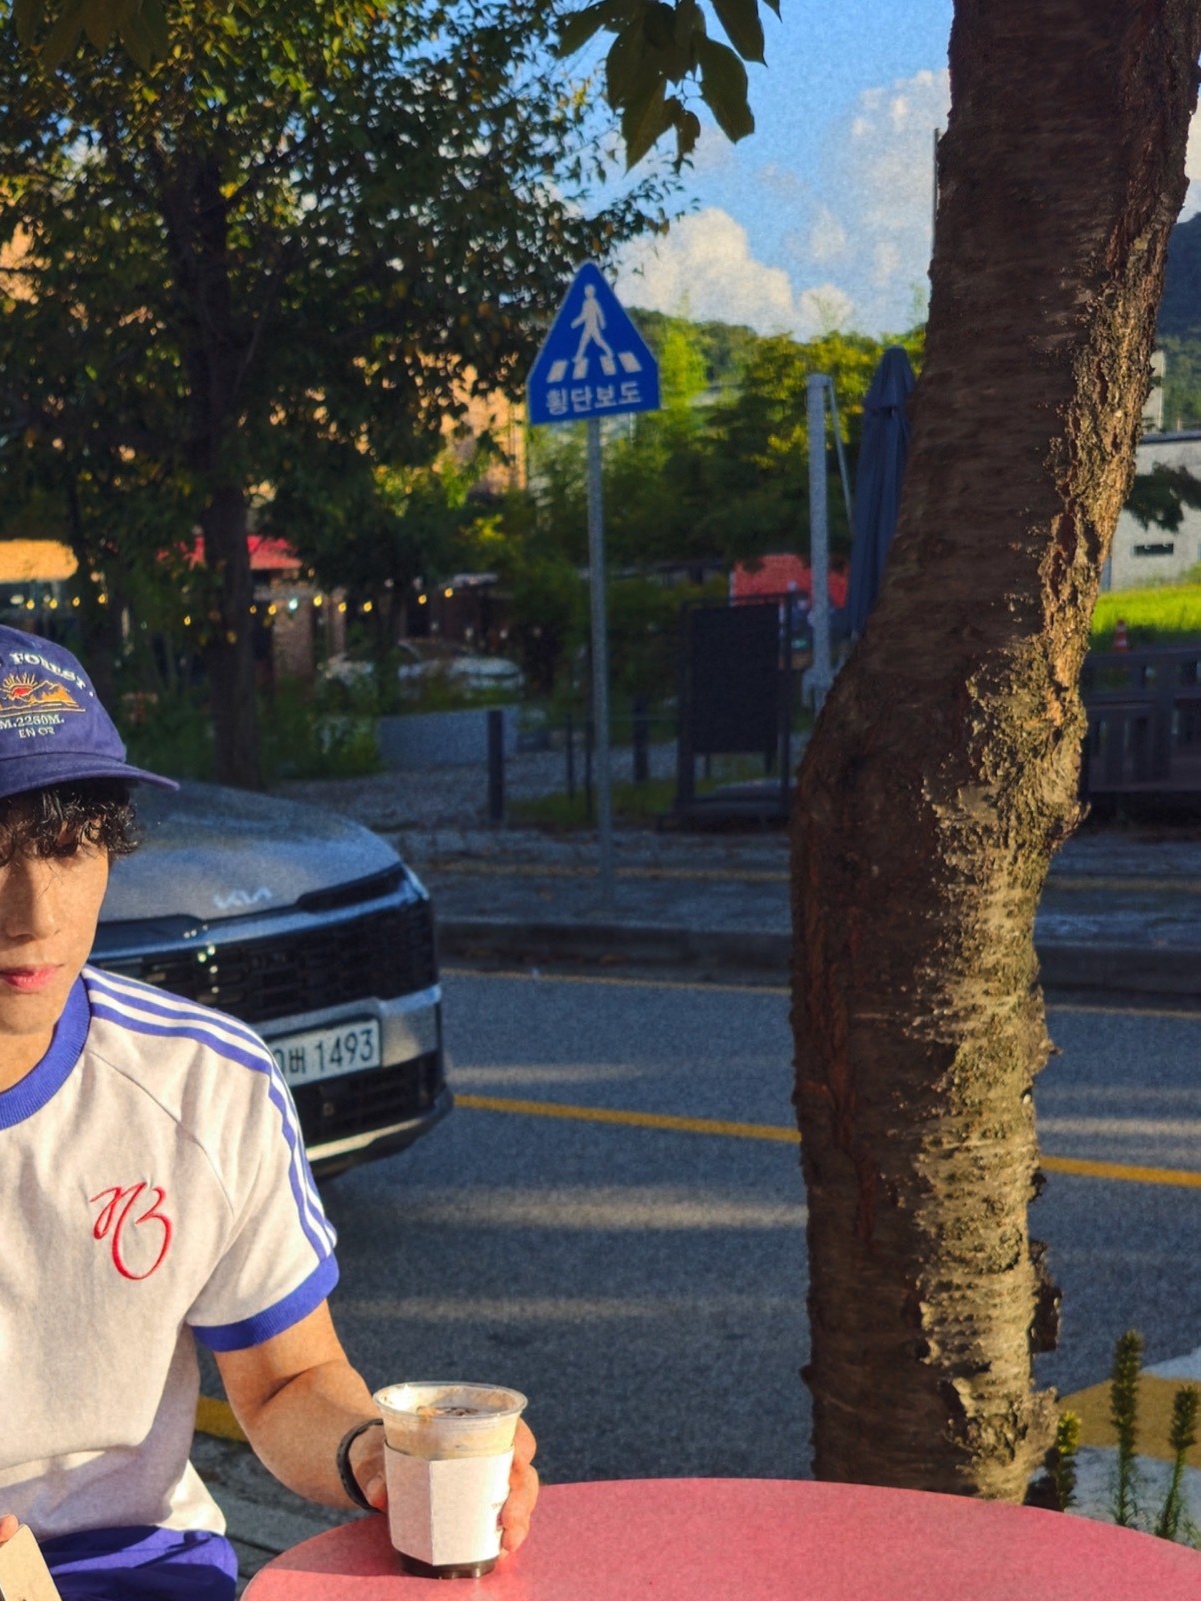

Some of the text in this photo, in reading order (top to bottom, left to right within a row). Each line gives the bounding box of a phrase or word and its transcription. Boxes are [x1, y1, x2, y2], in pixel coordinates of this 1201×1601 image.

[546, 380, 642, 416] 횡단보도
[9, 652, 87, 690] FOREST
[18, 727, 36, 739] EN
[315, 1028, 374, 1072] 1493
